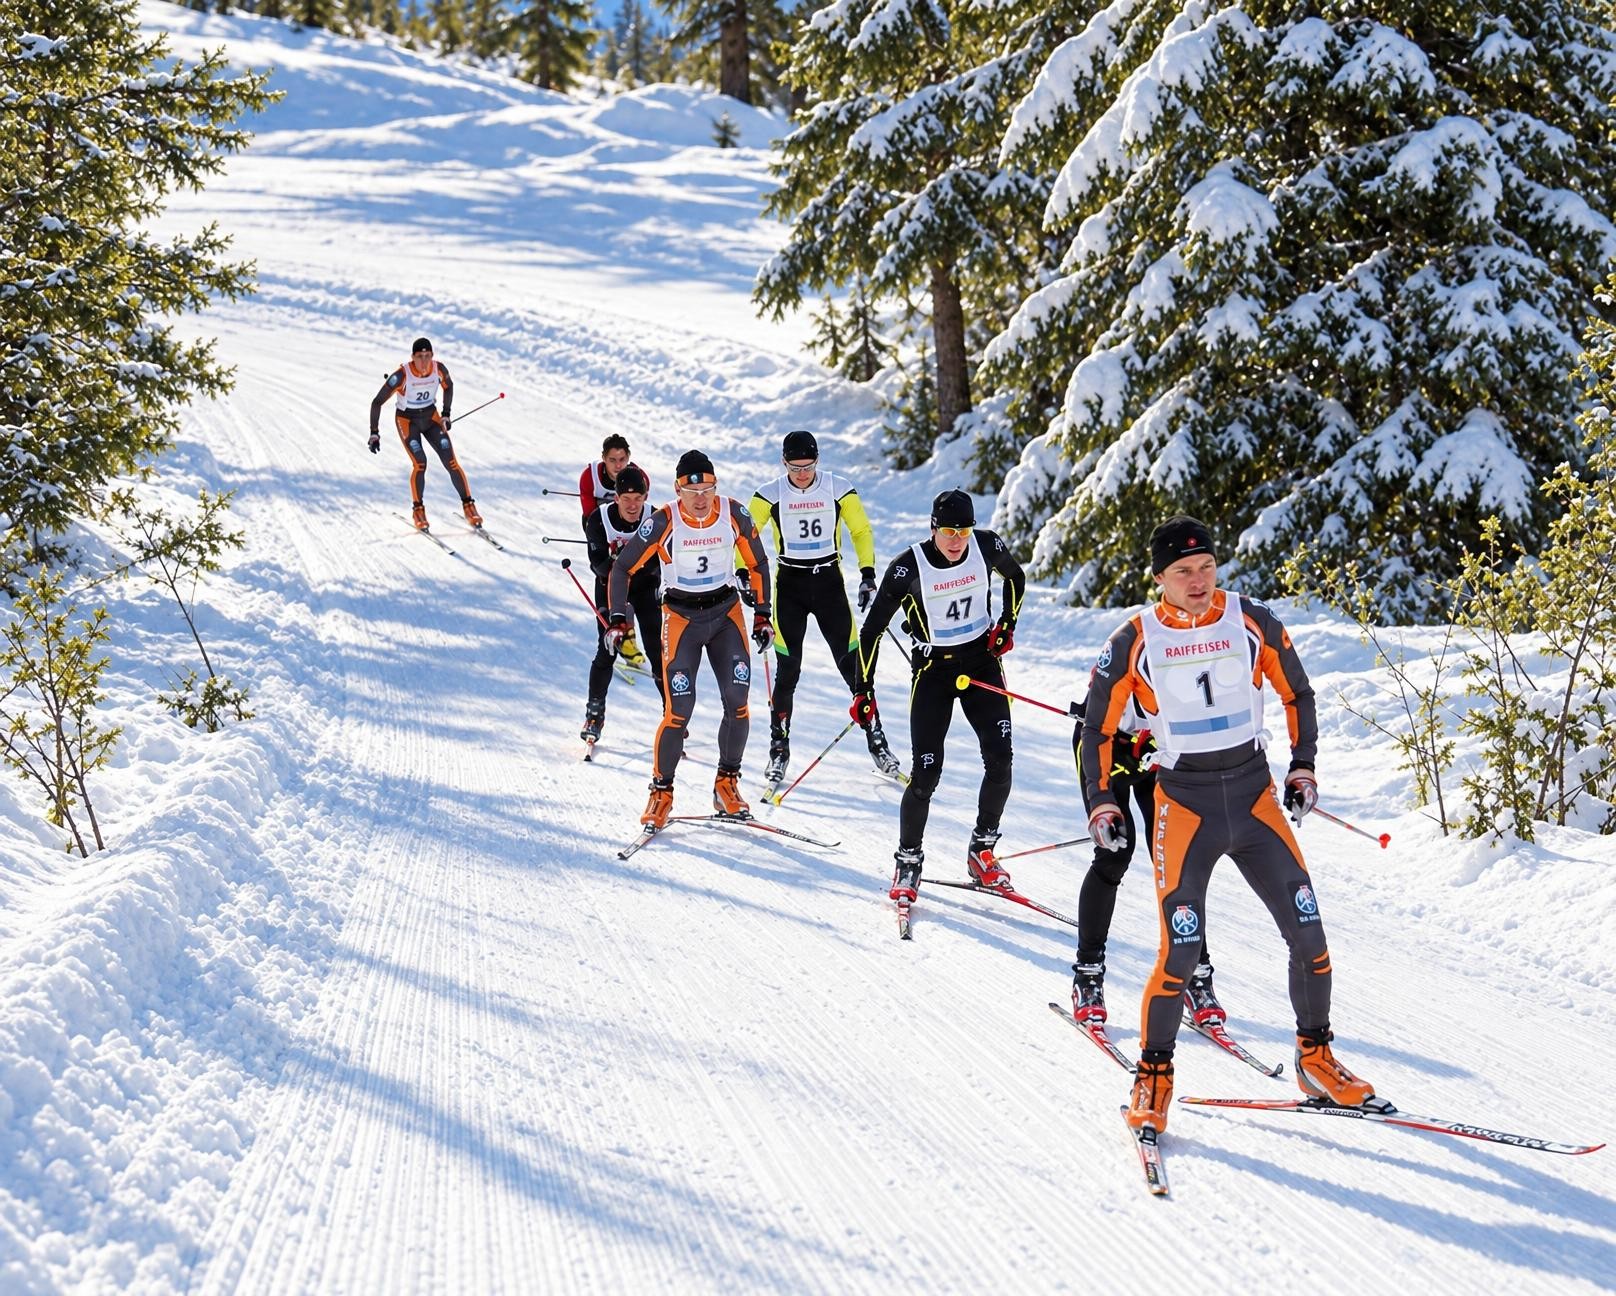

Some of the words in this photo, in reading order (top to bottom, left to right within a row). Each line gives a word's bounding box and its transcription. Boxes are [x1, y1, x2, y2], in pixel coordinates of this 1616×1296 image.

[416, 391, 430, 401] 20
[799, 518, 822, 539] 36
[696, 556, 708, 574] 3
[933, 574, 976, 592] RAIFFEISEN
[945, 595, 973, 622] 47
[1165, 639, 1231, 658] RAIFFEISEN
[1195, 670, 1215, 708] 1
